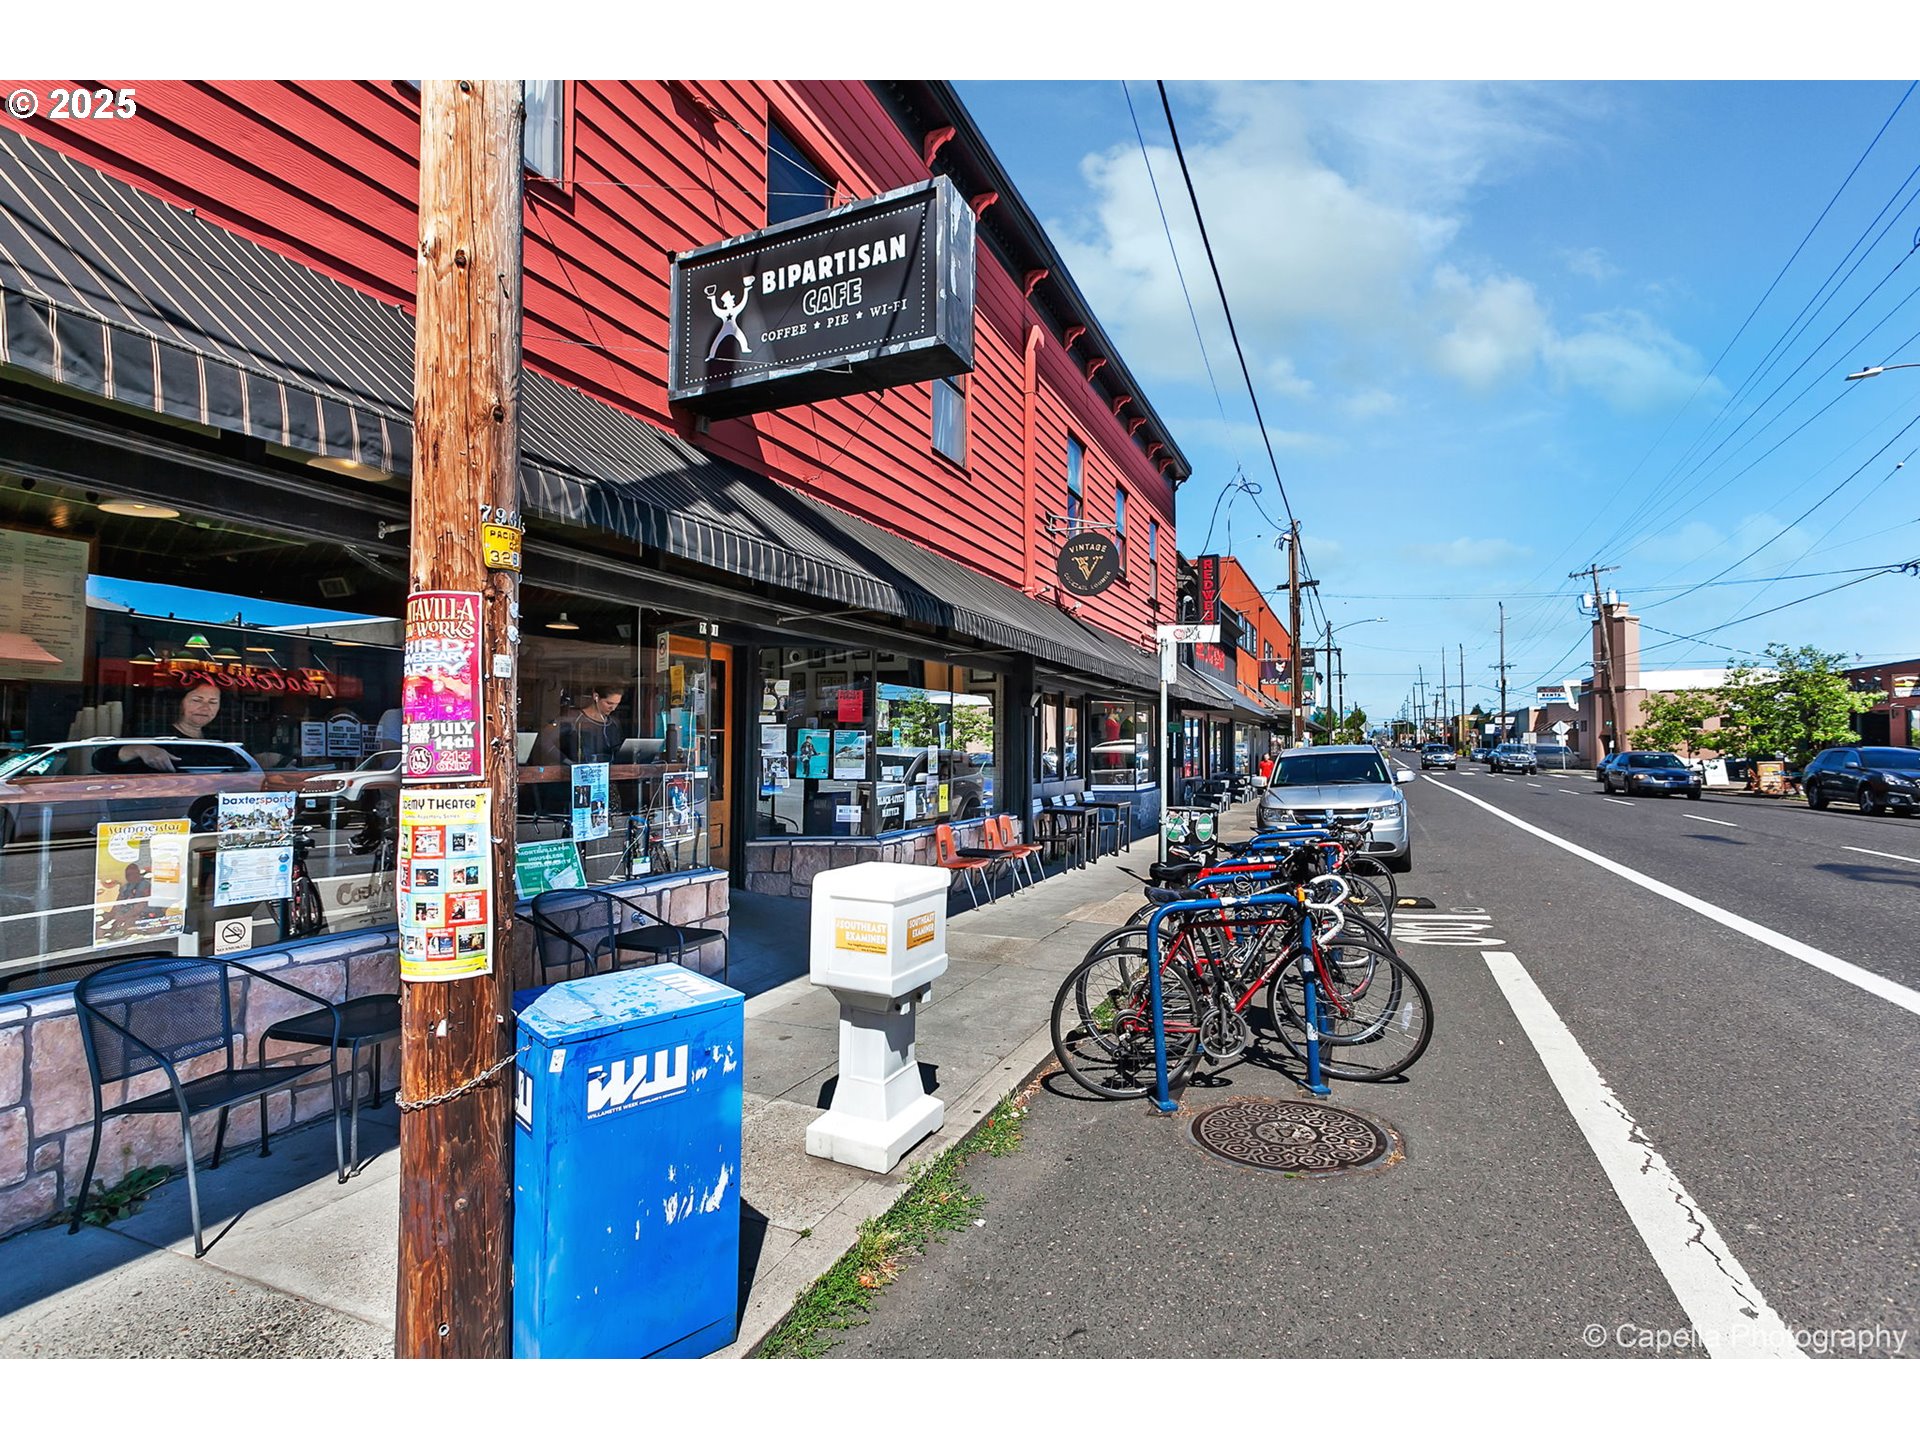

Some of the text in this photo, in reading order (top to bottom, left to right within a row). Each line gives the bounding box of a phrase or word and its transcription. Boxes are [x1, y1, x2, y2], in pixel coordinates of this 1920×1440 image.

[762, 234, 906, 294] BIPARTISAN
[803, 277, 862, 316] CAFE
[761, 297, 908, 343] COFFEE PIE WI-FI
[1069, 543, 1107, 553] VINTAGE
[1202, 559, 1214, 625] REDWOO
[405, 638, 466, 655] HIRD
[404, 659, 468, 678] ARTY
[431, 720, 476, 738] JULY
[434, 735, 475, 752] 14th
[440, 750, 471, 762] 21+
[436, 761, 472, 772] ONLY
[427, 799, 476, 810] THEATER
[845, 931, 887, 945] EXAMINER
[587, 1105, 622, 1120] WILLAMETTE
[623, 1101, 639, 1110] WEEK
